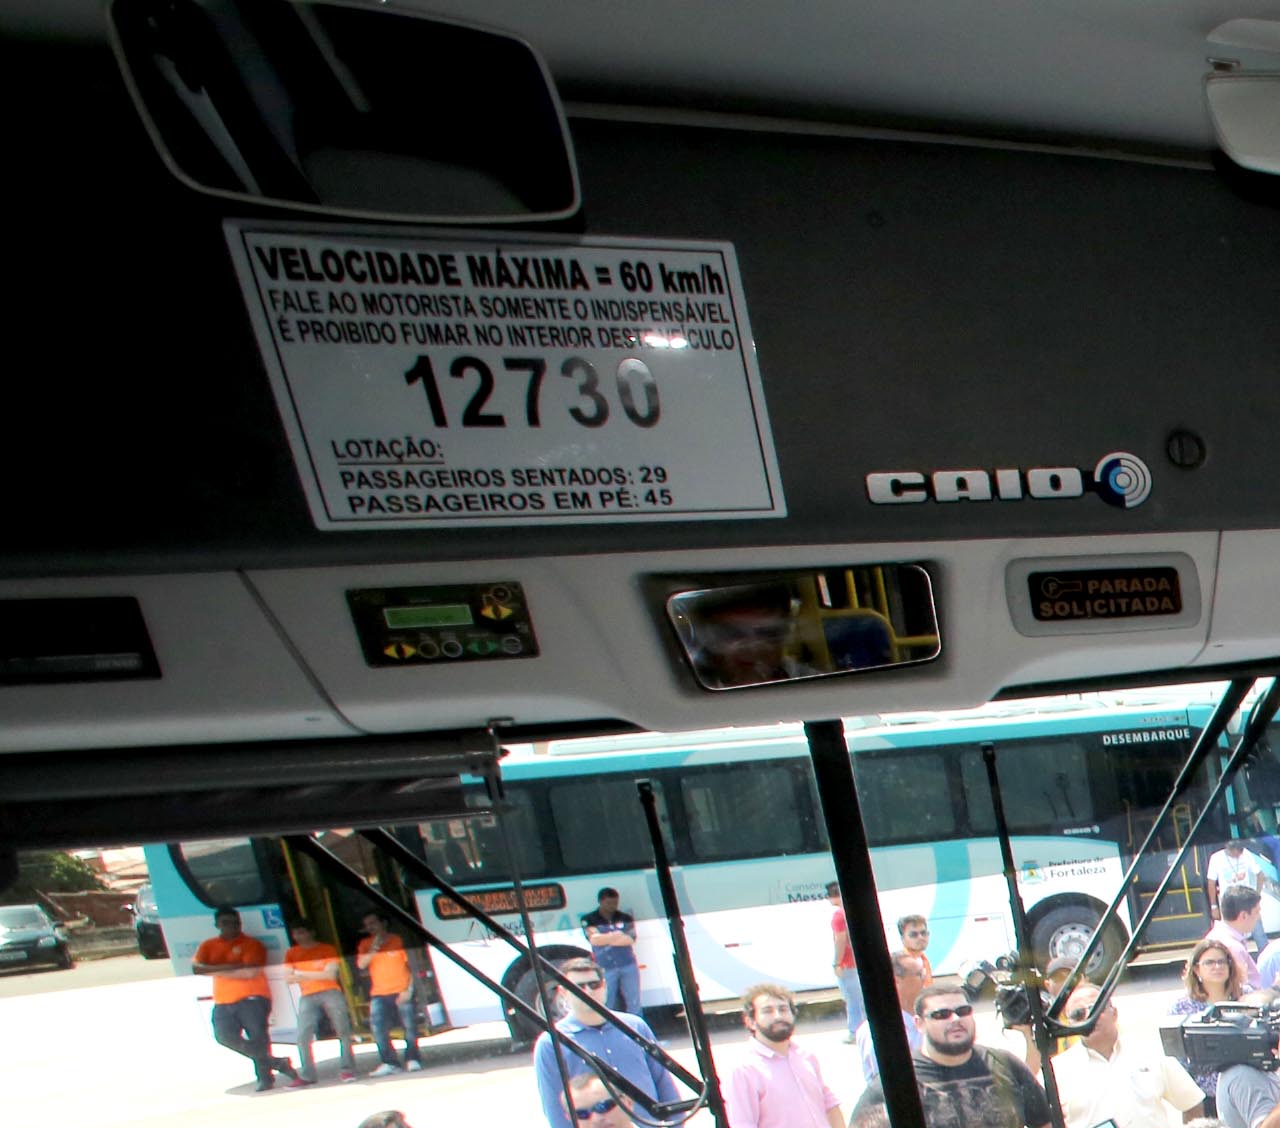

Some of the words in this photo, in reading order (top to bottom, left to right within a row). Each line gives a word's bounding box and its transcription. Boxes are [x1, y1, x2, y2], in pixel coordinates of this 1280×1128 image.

[255, 246, 461, 286] VELOCIDADE
[466, 249, 589, 291] MÁXIMA
[597, 266, 612, 285] =
[620, 262, 652, 293] 60
[659, 263, 725, 295] km/h
[268, 290, 324, 314] FALE
[328, 292, 358, 315] AO
[362, 294, 477, 318] MOTORISTA
[481, 297, 571, 321] SOMENTE
[574, 301, 589, 320] O
[592, 298, 731, 325] INDISPENSÁVEL
[279, 316, 295, 342] É
[298, 320, 397, 345] PROIBIDO
[400, 323, 472, 346] FUMAR
[474, 325, 503, 347] NO
[507, 325, 595, 349] INTERIOR
[405, 353, 662, 431] 12730
[331, 437, 444, 463] LOTAÇÃO:
[339, 470, 506, 490] PASSAGEIROS
[511, 467, 635, 487] SENTADOS:
[639, 466, 668, 484] 29
[866, 467, 1084, 505] CAIO
[348, 491, 546, 515] PASSAGEIROS
[553, 493, 592, 510] EM
[598, 486, 641, 509] PÉ:
[645, 488, 674, 506] 45
[1087, 575, 1172, 595] PARADA
[1039, 595, 1176, 618] SOLICITADA
[1102, 728, 1191, 746] DESEMBARQUE
[1049, 866, 1107, 879] Fortaleza
